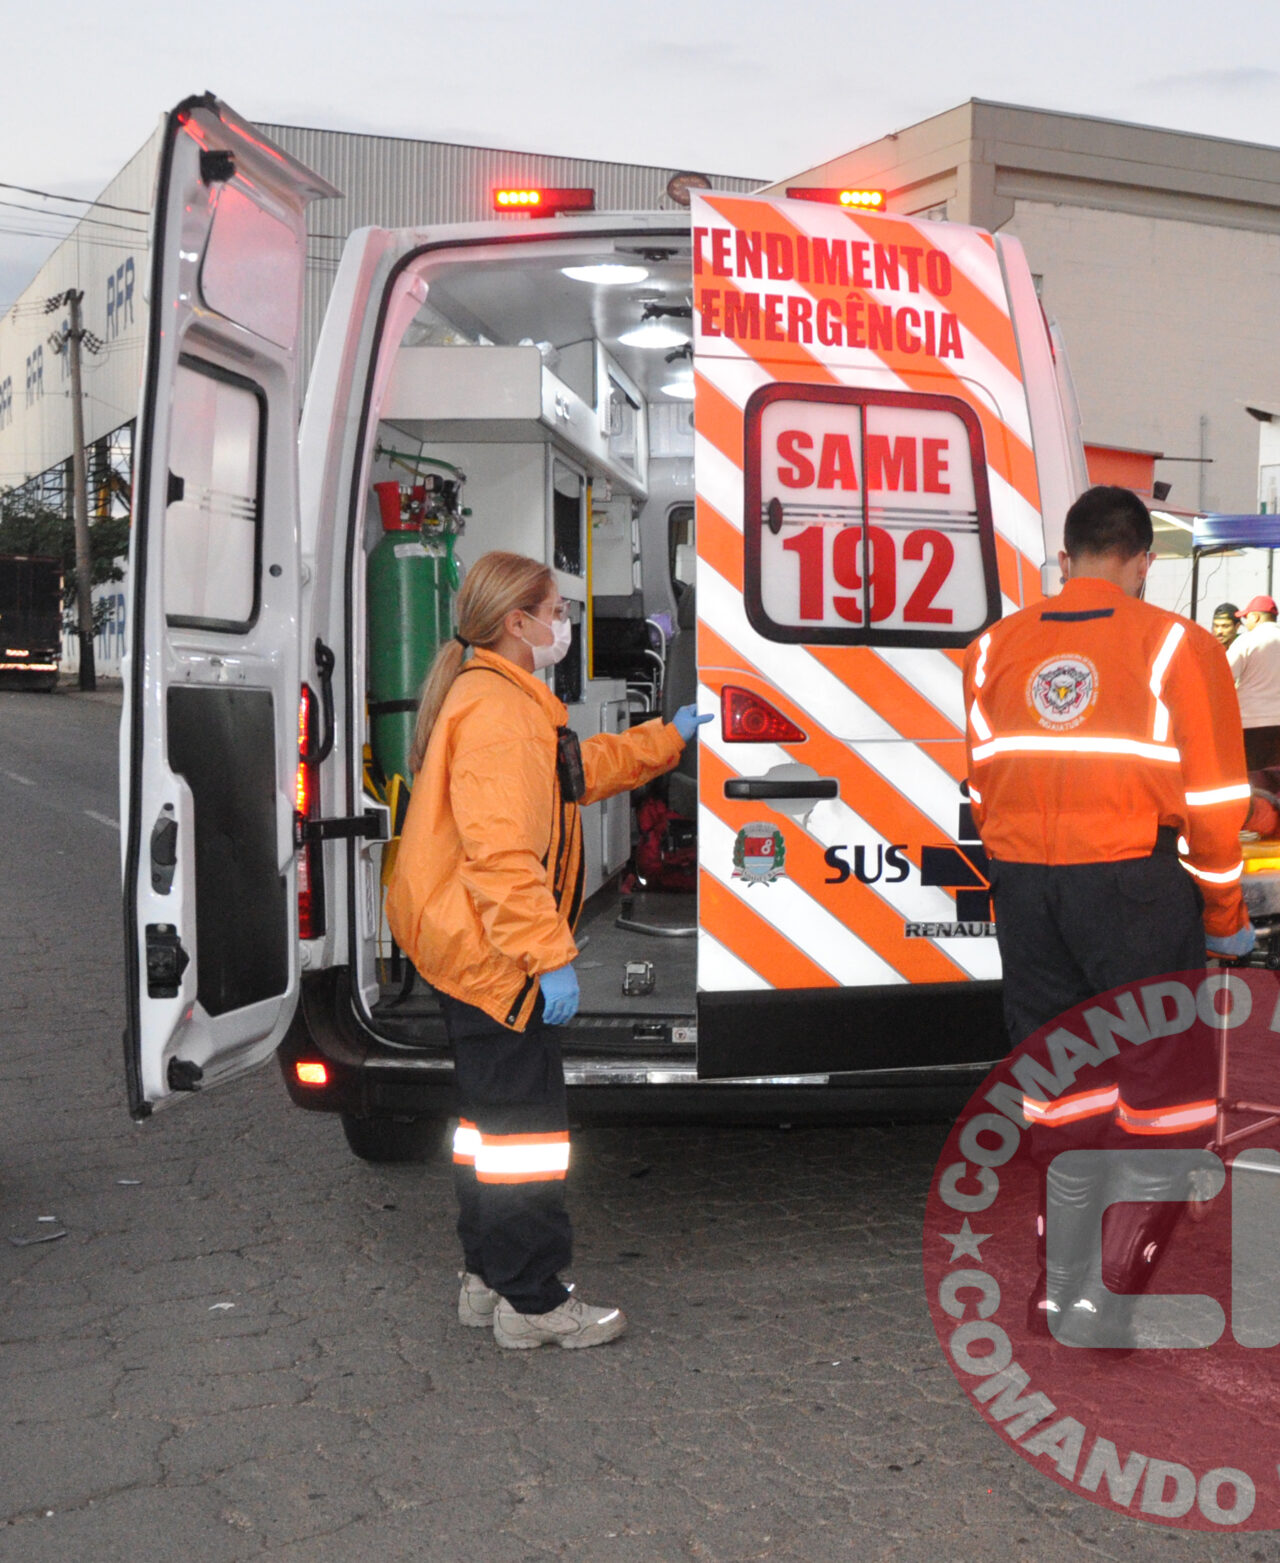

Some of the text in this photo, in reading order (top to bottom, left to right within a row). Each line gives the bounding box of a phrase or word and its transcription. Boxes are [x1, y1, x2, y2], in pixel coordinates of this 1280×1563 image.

[693, 226, 953, 297] TENDIMENTO
[701, 288, 964, 360] EMERGÊNCIA
[776, 430, 951, 494] SAME
[783, 525, 955, 625] 192
[824, 844, 911, 884] SUS
[905, 922, 998, 938] RENAUL
